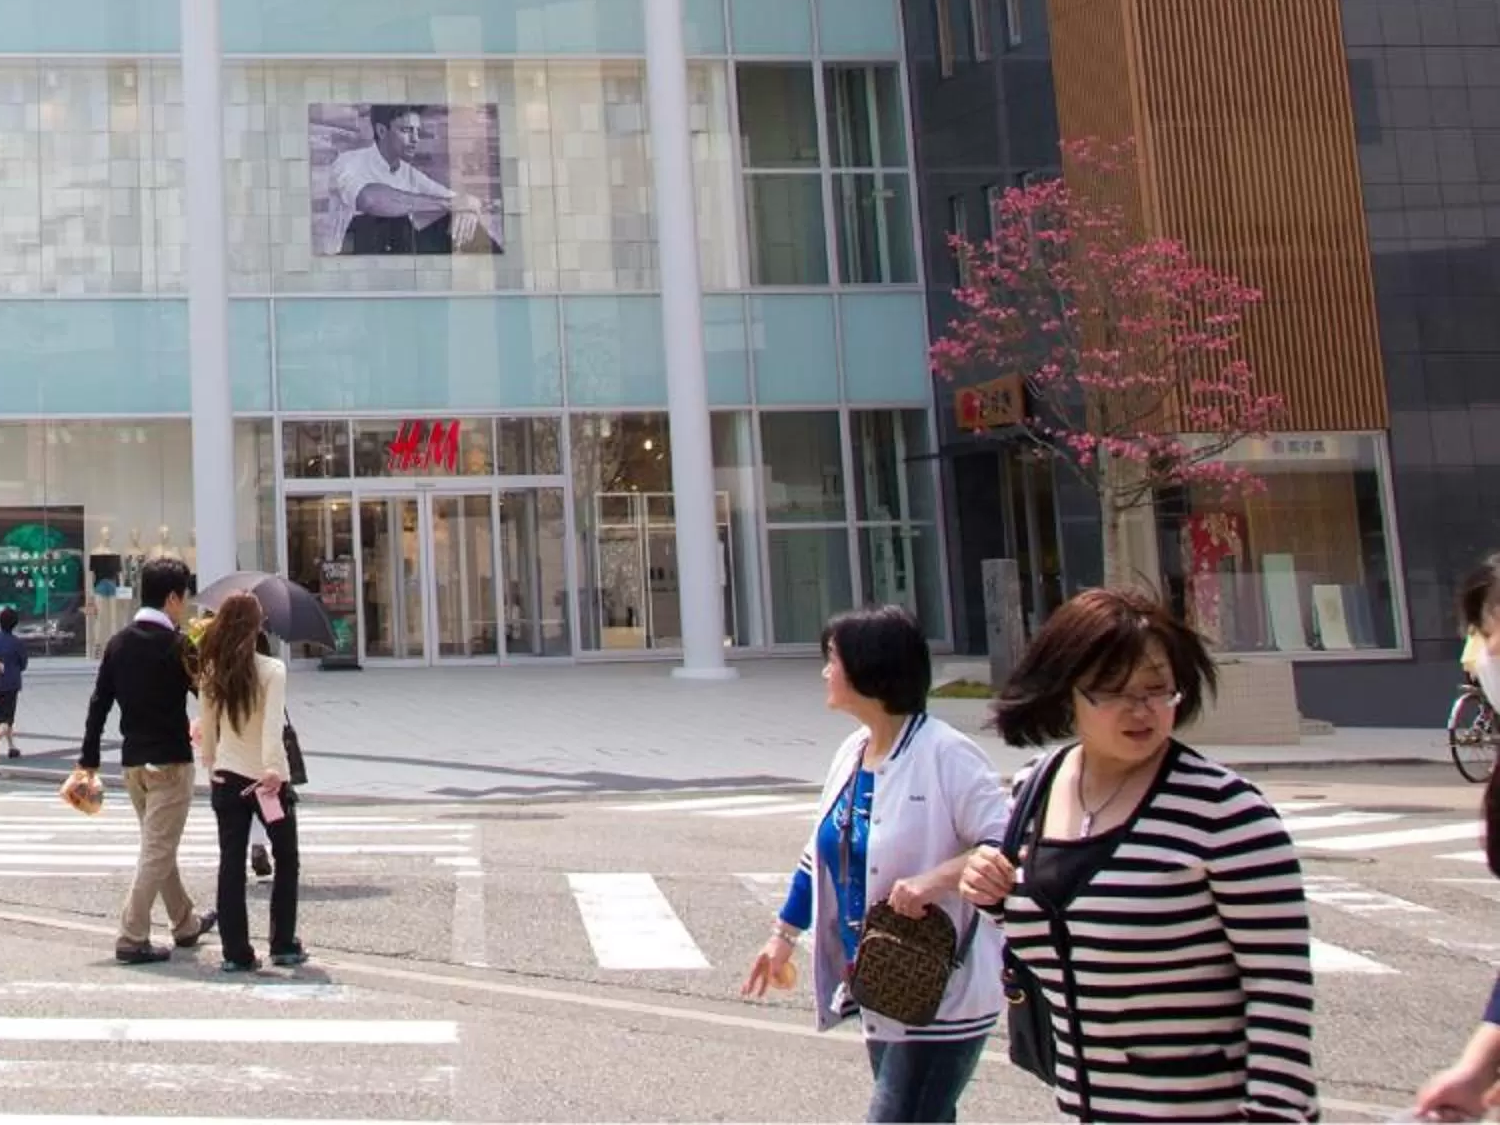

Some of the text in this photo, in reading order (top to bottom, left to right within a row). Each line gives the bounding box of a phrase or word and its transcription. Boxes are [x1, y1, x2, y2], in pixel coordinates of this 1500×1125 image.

[386, 418, 461, 474] H&M
[2, 565, 67, 574] RECYCLE
[15, 578, 56, 588] WEEK
